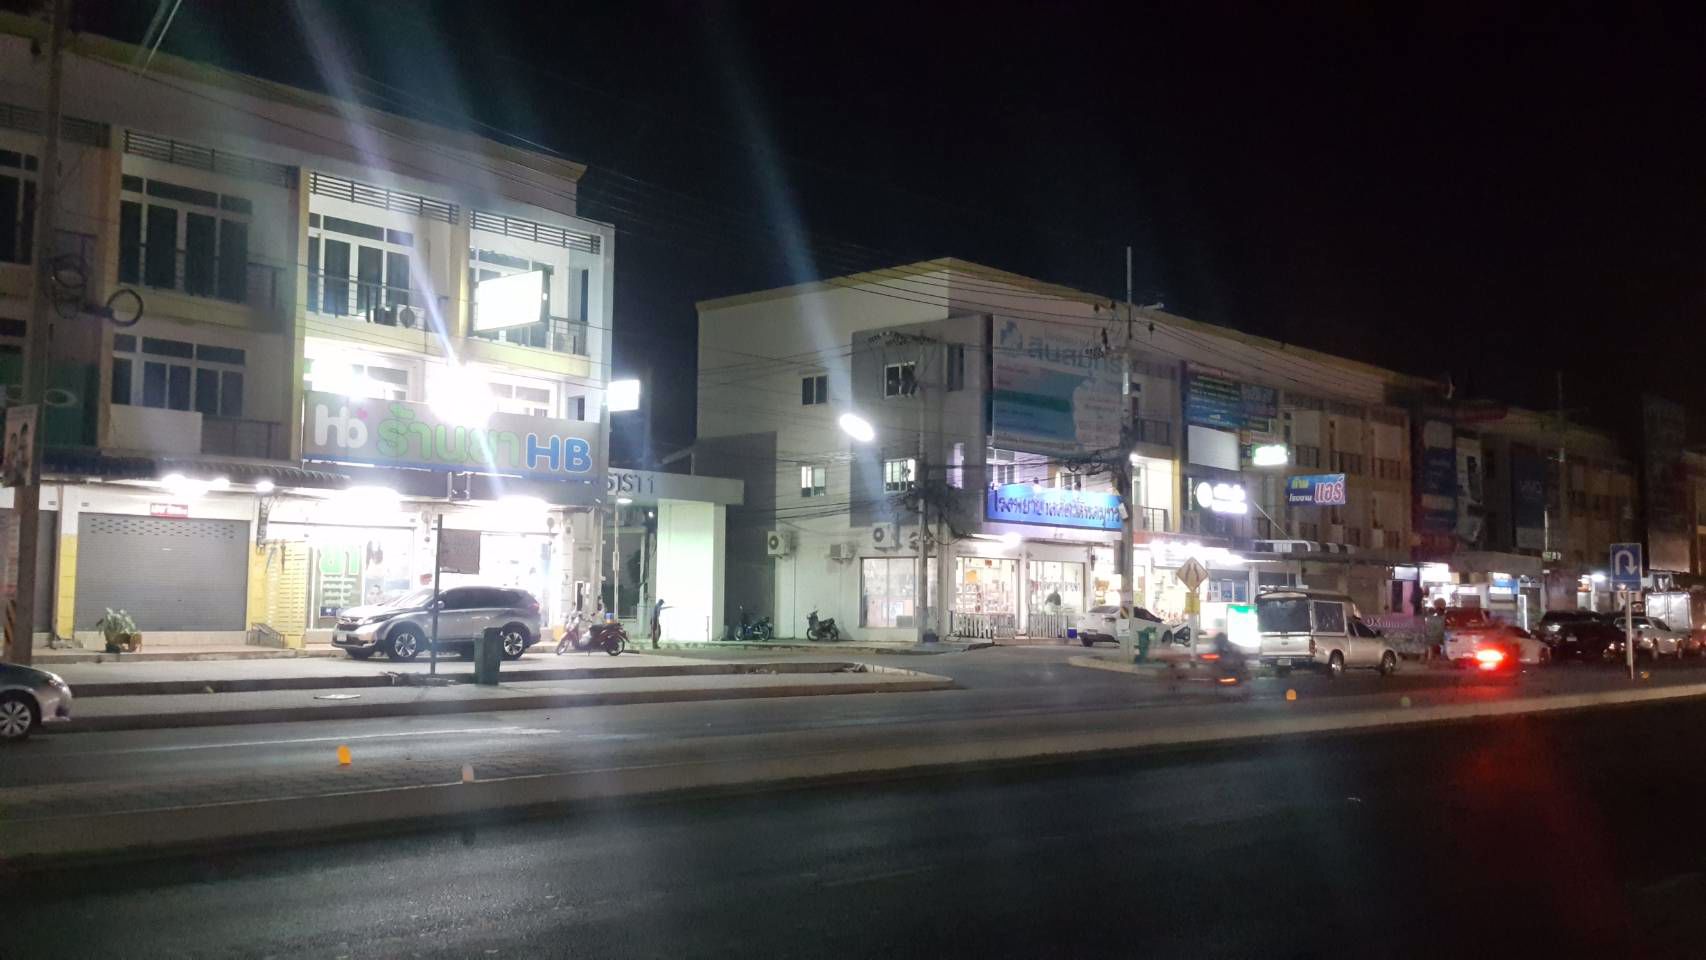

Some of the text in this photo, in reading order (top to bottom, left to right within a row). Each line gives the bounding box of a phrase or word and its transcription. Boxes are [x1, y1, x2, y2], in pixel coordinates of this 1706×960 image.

[376, 402, 521, 467] ร้านยา
[525, 432, 593, 474] HB
[1314, 475, 1344, 504] แอร์
